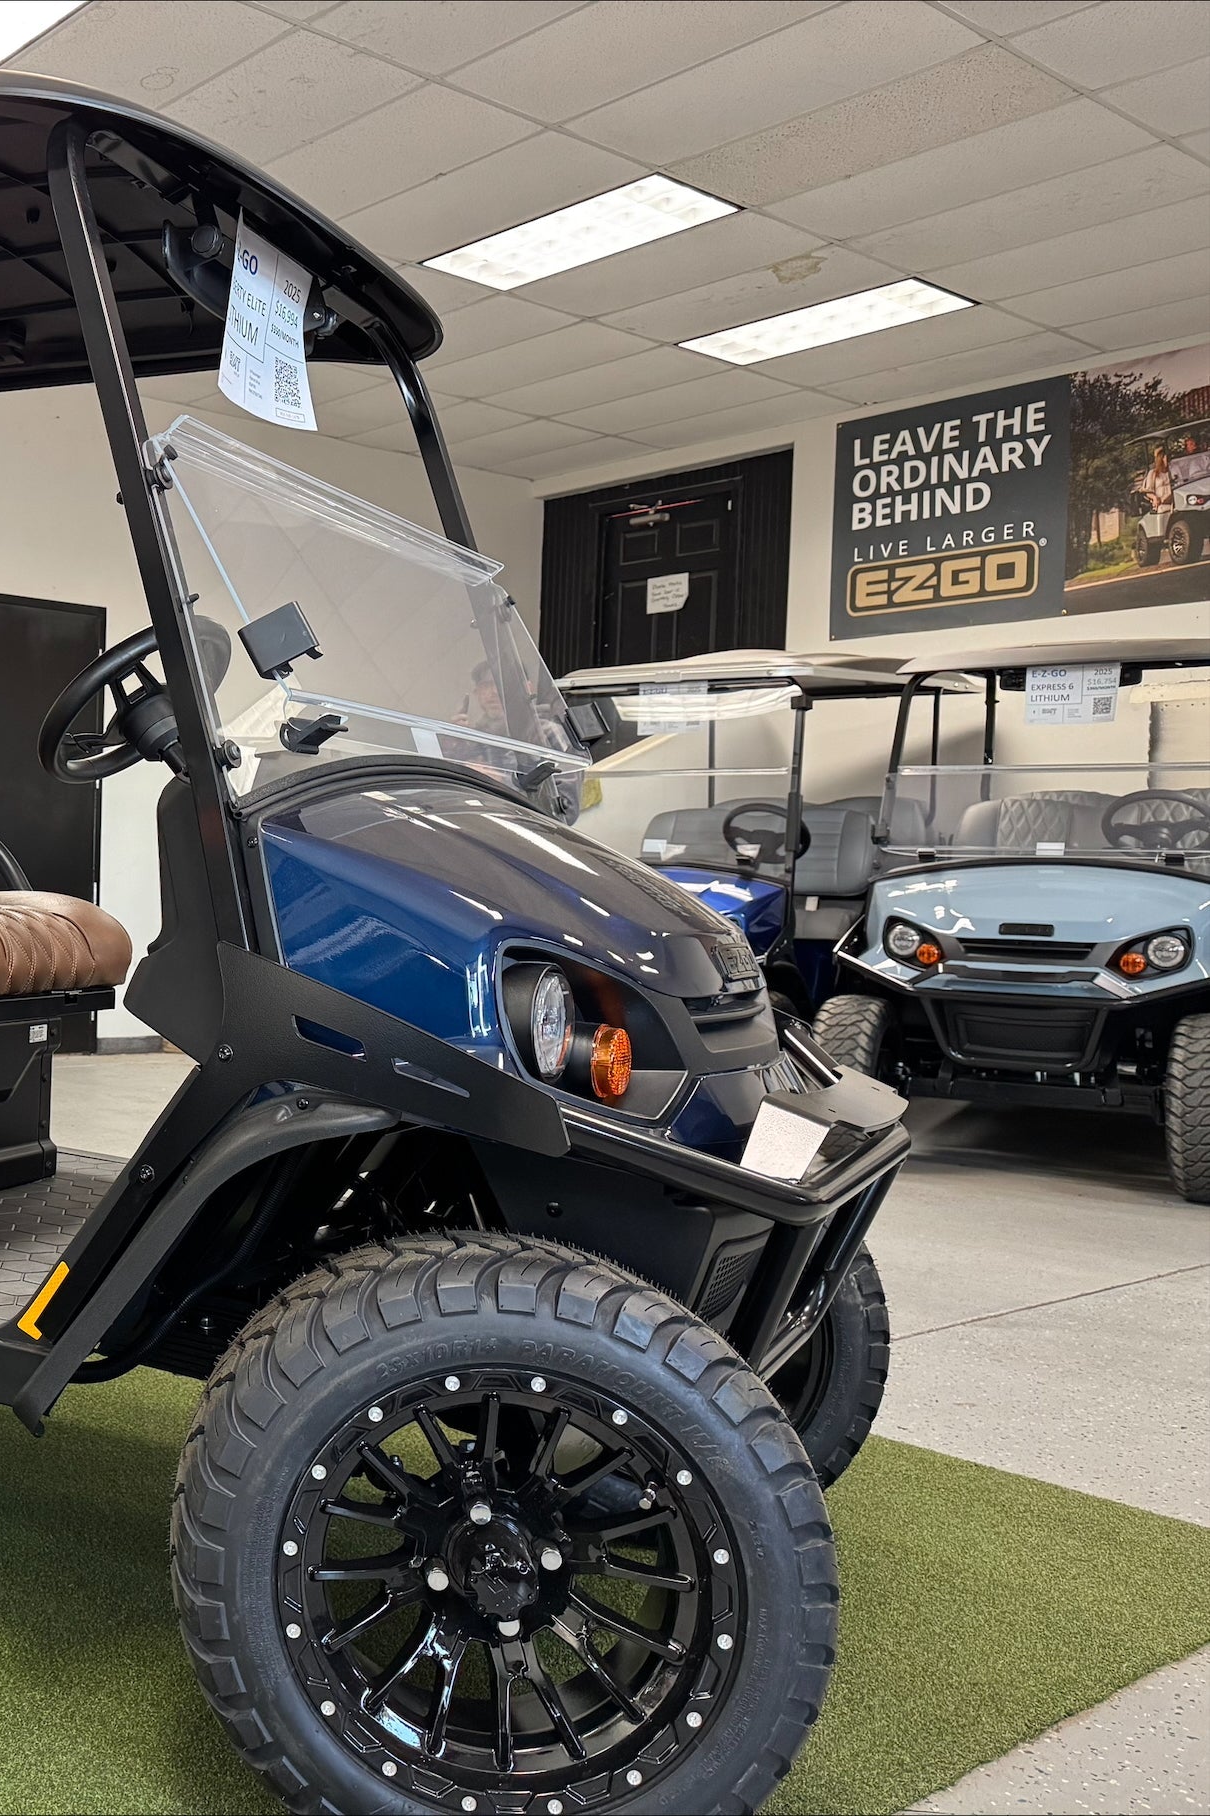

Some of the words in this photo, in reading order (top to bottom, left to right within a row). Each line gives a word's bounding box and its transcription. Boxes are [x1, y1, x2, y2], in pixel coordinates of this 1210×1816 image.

[247, 293, 266, 317] ELITE
[283, 279, 301, 303] 2025
[853, 419, 961, 467] LEAVE
[972, 400, 1046, 442] THE
[852, 434, 1052, 498] ORDINARY
[851, 481, 992, 531] BEHIND
[853, 540, 909, 562] LIVE
[926, 521, 1036, 551] LARGER
[854, 550, 1028, 608] EZGO
[1031, 669, 1067, 678] E-Z-GO
[1031, 683, 1066, 691] EXPRESS
[1068, 682, 1074, 690] 6
[1094, 668, 1113, 676] 2025
[1030, 694, 1070, 702] LITHIUM
[519, 1338, 688, 1421] PARAMOUNT
